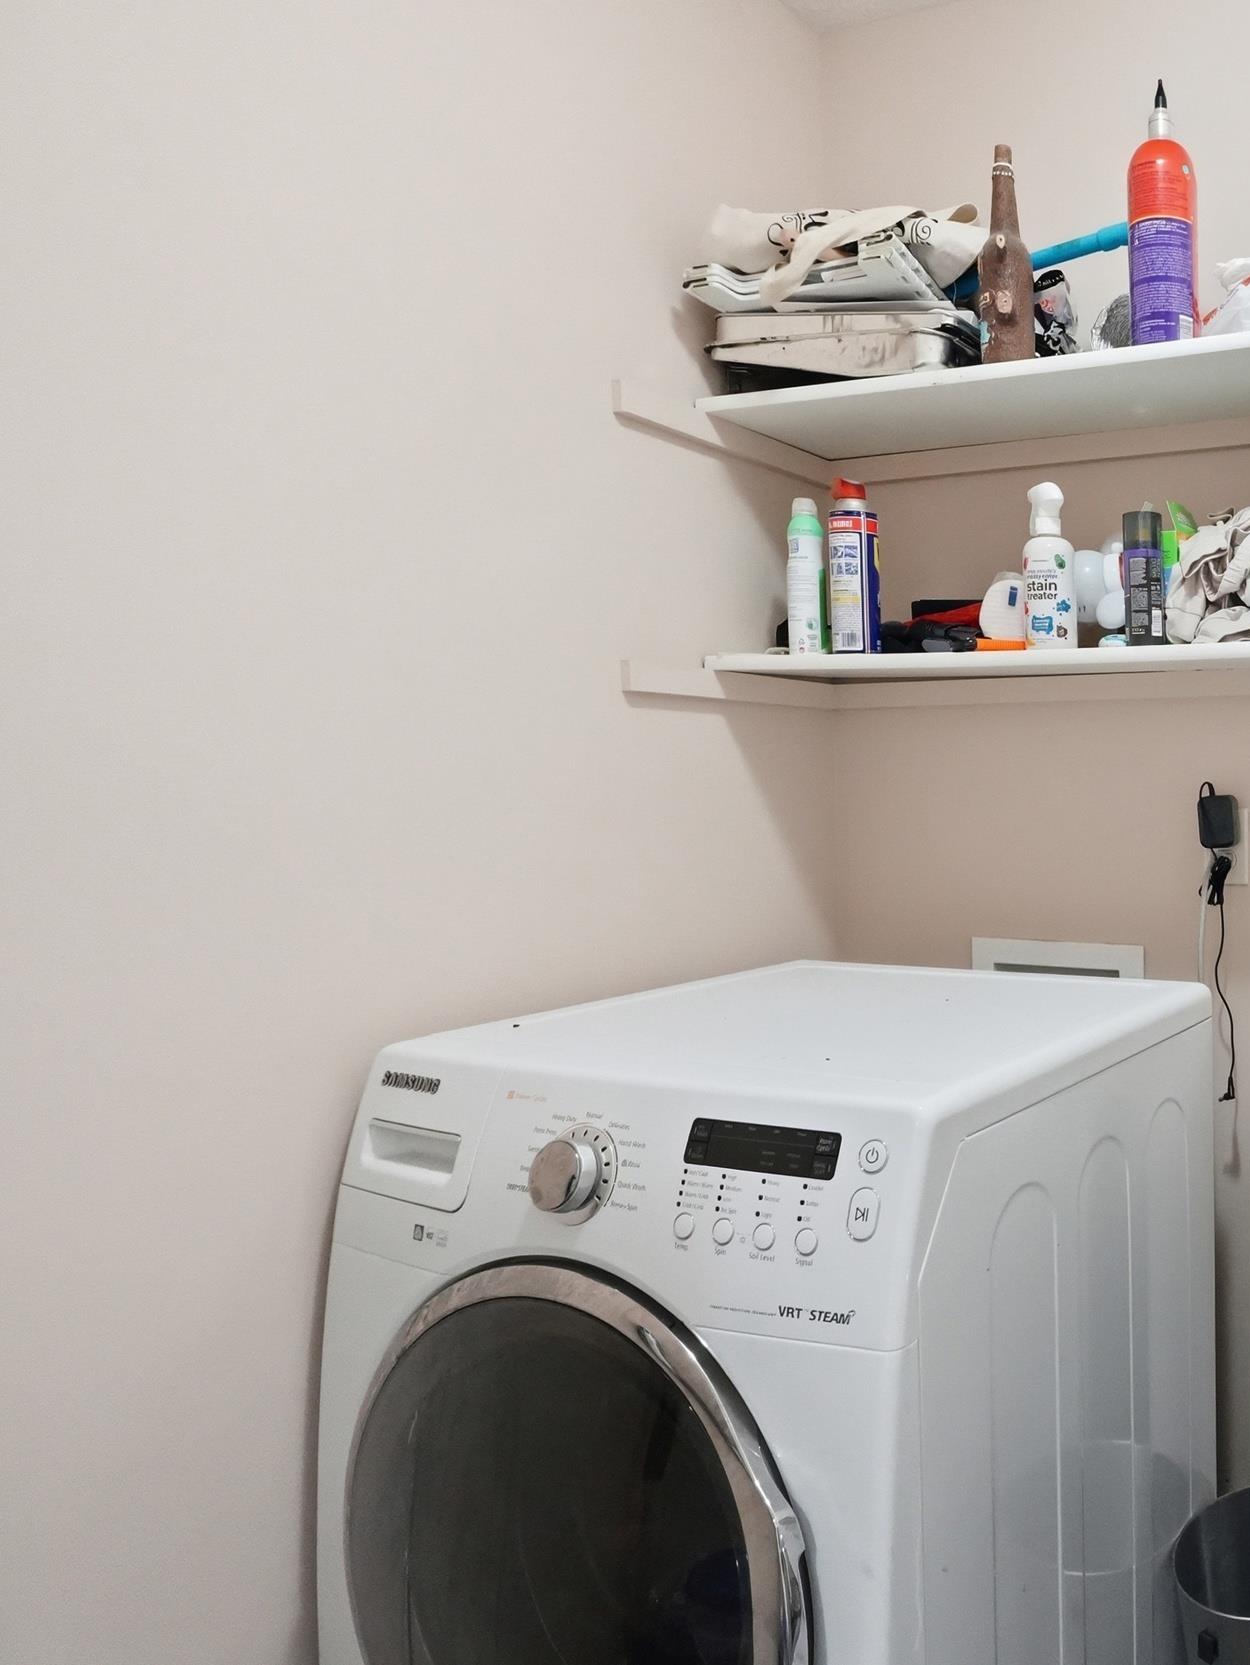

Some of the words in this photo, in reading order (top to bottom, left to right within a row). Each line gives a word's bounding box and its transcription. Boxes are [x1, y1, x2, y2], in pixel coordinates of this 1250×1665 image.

[1027, 578, 1058, 592] stain
[1027, 592, 1058, 601] treater
[381, 1070, 441, 1095] SAMSUNG
[674, 1241, 689, 1251] Temp
[714, 1247, 727, 1257] Spin
[748, 1252, 759, 1261] Soil
[759, 1254, 776, 1263] Level
[795, 1257, 814, 1267] Signal
[778, 1305, 804, 1319] VRT
[809, 1309, 854, 1325] STEAM
